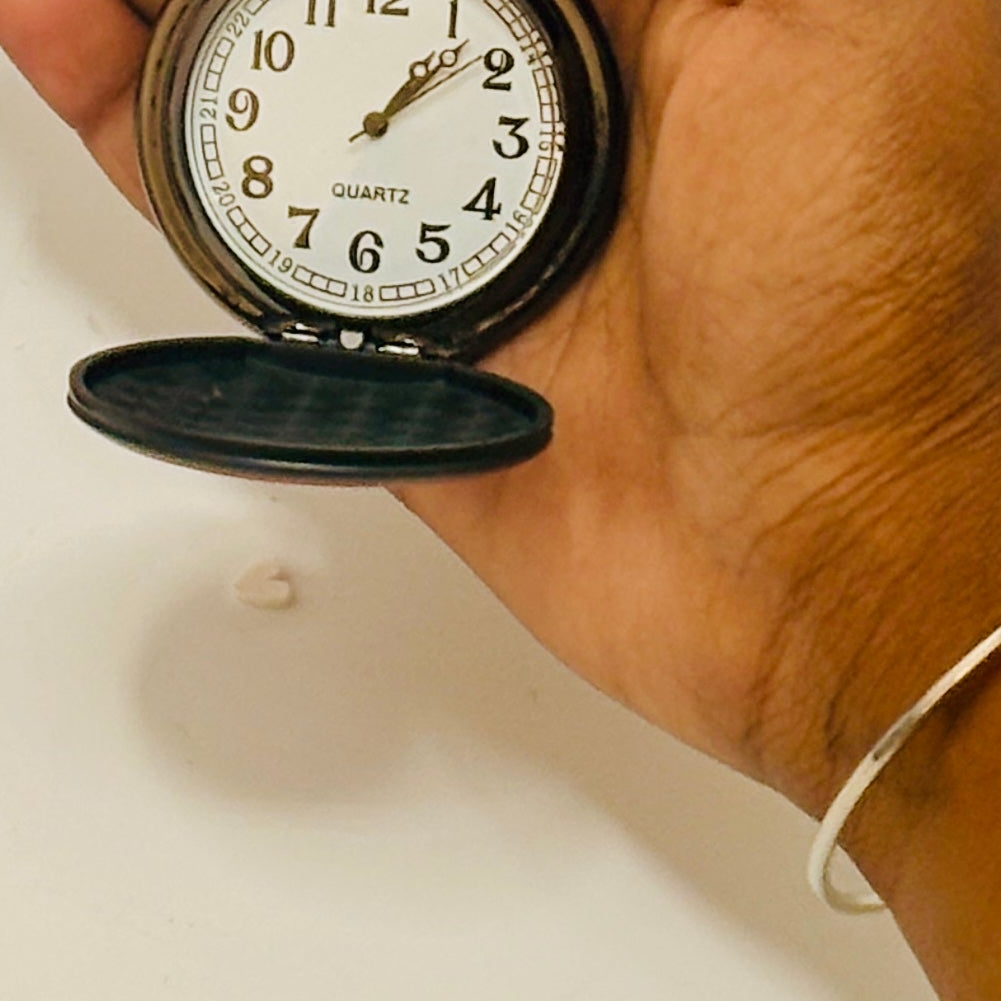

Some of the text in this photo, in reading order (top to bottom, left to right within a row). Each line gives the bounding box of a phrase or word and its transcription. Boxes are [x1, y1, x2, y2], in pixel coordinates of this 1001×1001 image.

[226, 10, 250, 38] 22
[250, 29, 296, 73] 10
[482, 47, 515, 92] 2
[200, 96, 218, 122] 21
[225, 87, 260, 132] 9
[492, 115, 530, 160] 3
[212, 181, 237, 207] 20
[241, 154, 275, 200] 8
[331, 182, 411, 205] QUARTZ
[461, 176, 503, 221] 4
[287, 205, 321, 250] 7
[415, 221, 452, 264] 5
[269, 250, 294, 274] 19
[348, 230, 385, 274] 6
[352, 285, 374, 302] 18
[438, 267, 464, 291] 17
